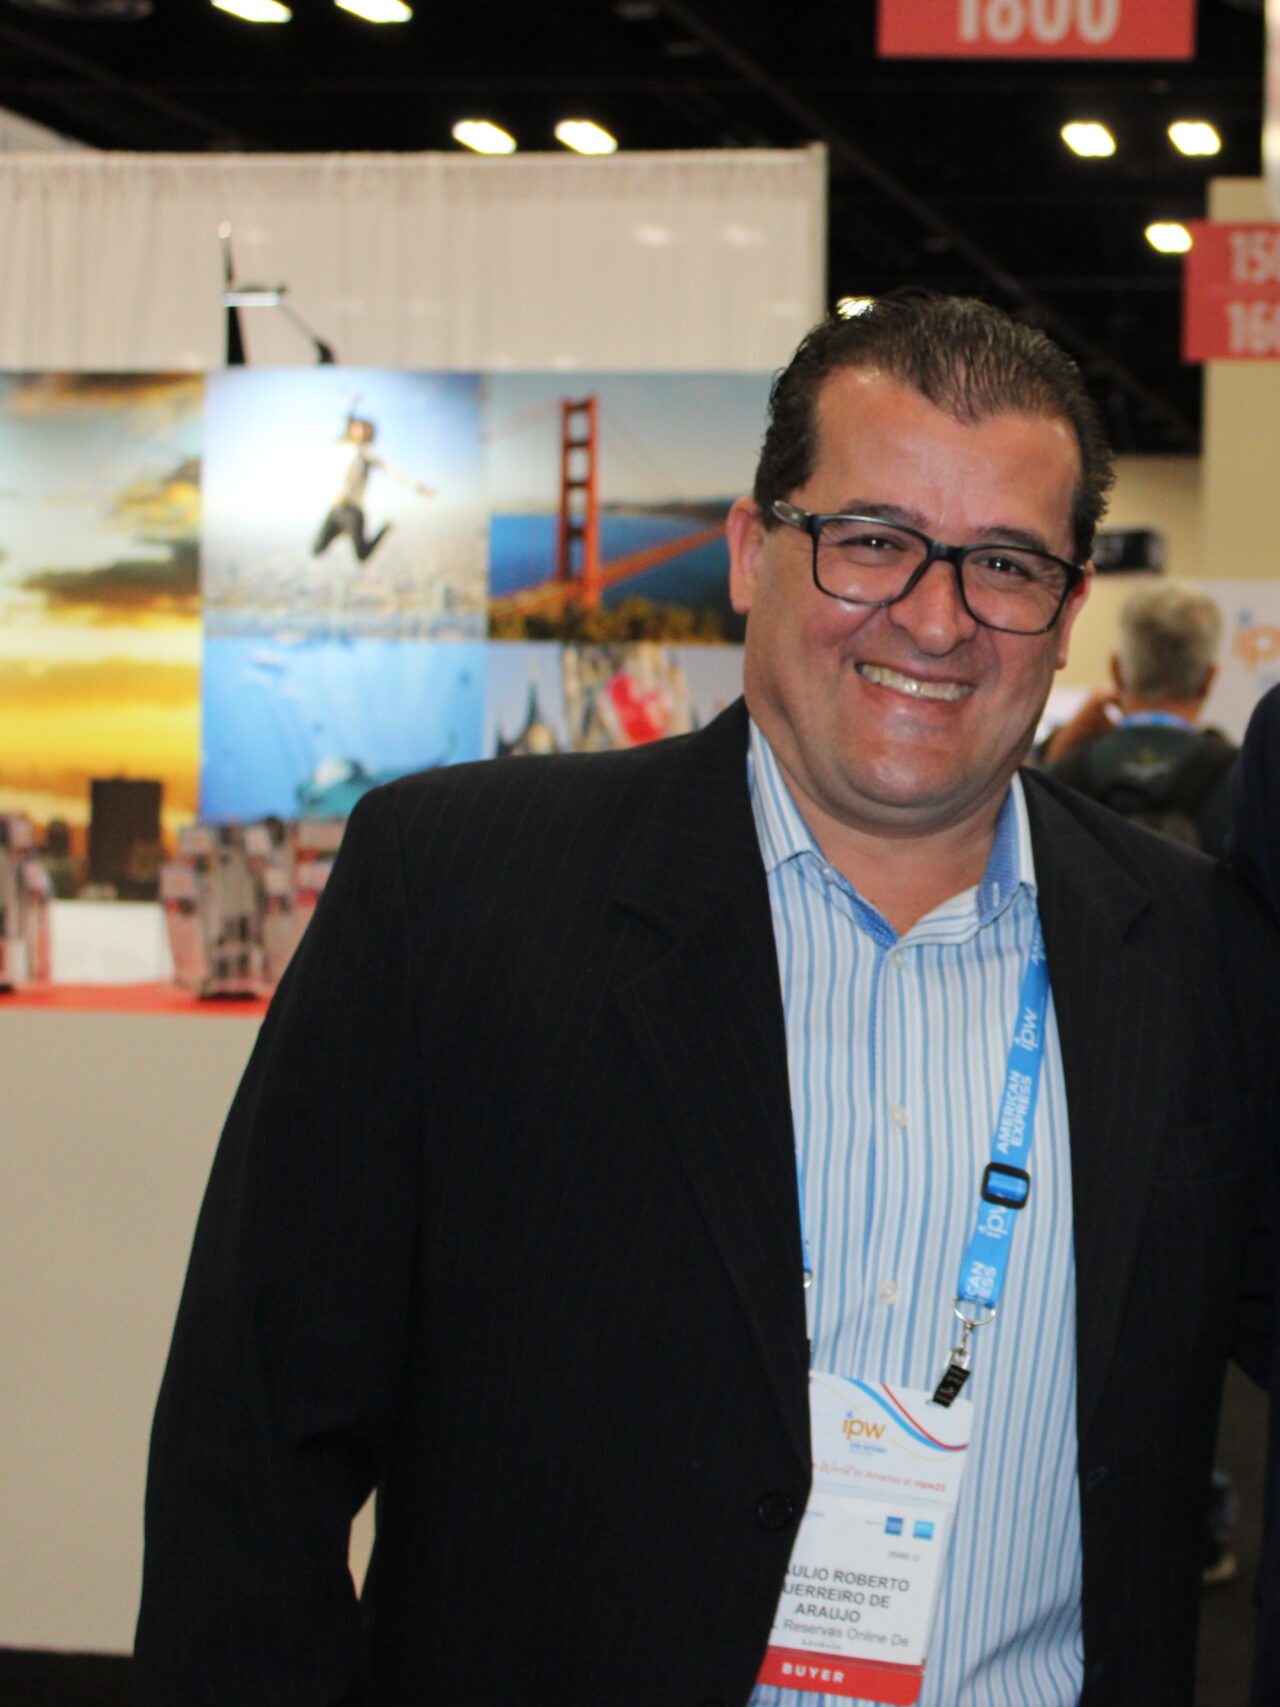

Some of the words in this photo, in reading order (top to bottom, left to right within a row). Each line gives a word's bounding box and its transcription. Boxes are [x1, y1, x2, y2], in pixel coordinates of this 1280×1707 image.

[1014, 1006, 1040, 1051] ipw
[996, 1070, 1022, 1155] AMERICAN
[1010, 1074, 1032, 1148] EXPRESS
[842, 1411, 887, 1440] ipw
[787, 1564, 829, 1581] ULIO
[834, 1570, 910, 1592] ROBERTO
[782, 1582, 865, 1605] UERREIRO
[869, 1594, 891, 1608] DE
[795, 1603, 861, 1623] ARAUJO
[784, 1619, 843, 1639] Reservas
[847, 1628, 888, 1644] Online
[891, 1634, 909, 1647] De
[782, 1662, 844, 1683] BUYER
